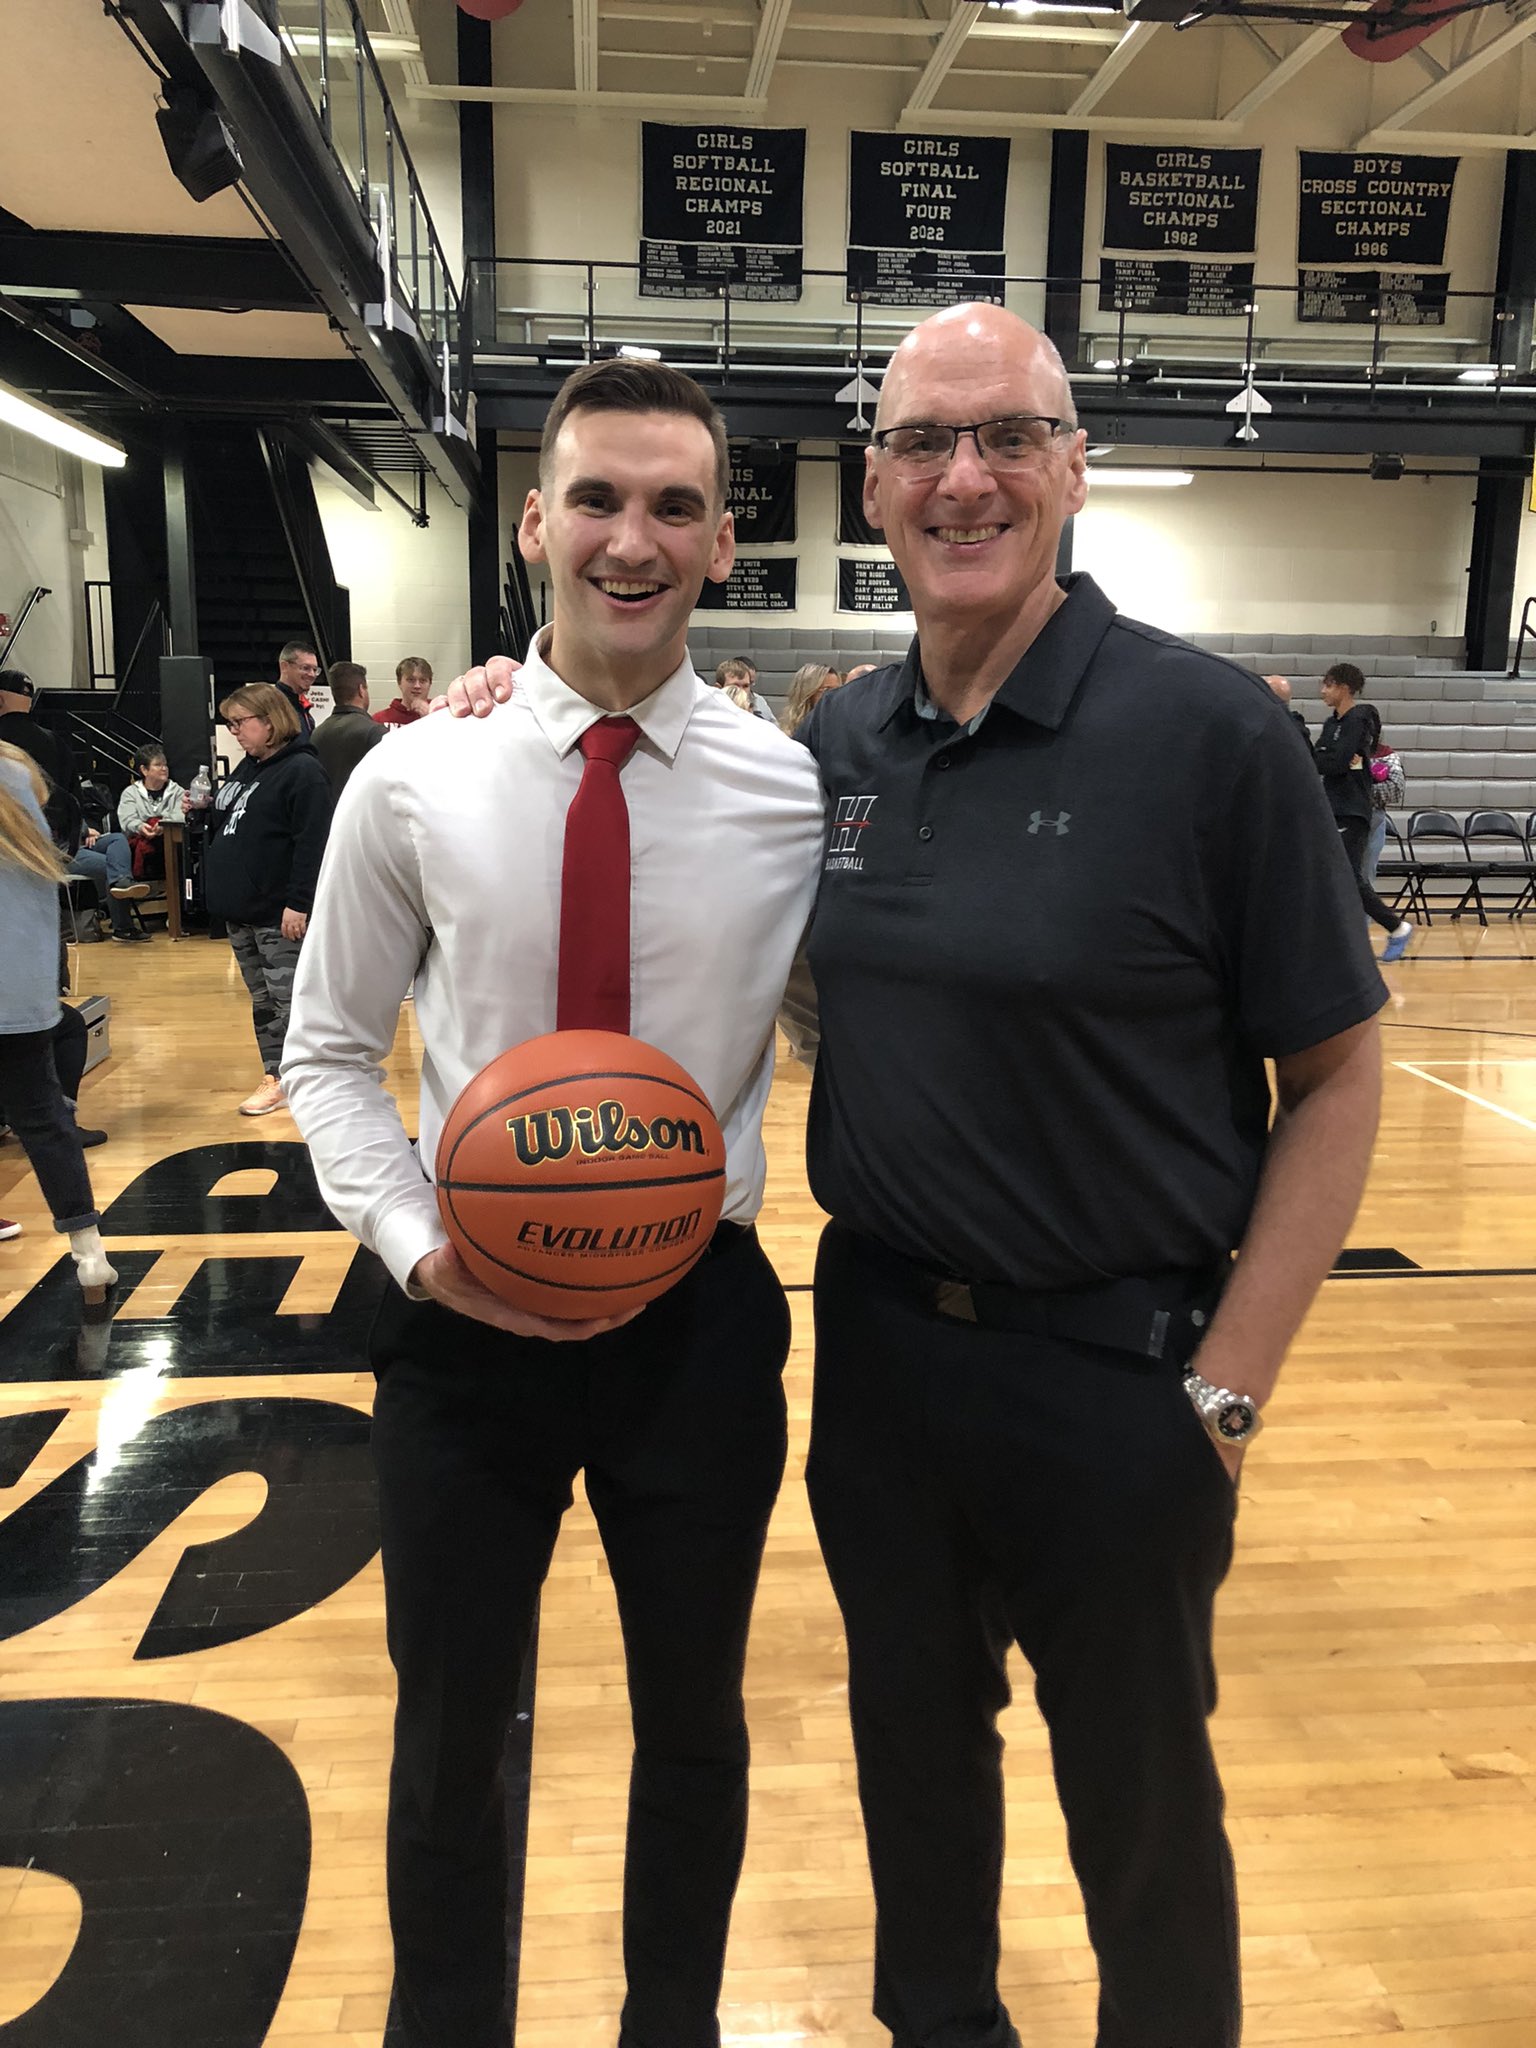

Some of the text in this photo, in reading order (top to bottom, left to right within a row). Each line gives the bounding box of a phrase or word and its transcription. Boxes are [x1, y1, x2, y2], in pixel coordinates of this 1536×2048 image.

[697, 133, 753, 150] GIRLS
[904, 139, 959, 156] GIRLS
[672, 155, 775, 173] SOFTBALL
[1156, 153, 1211, 168] GIRLS
[1354, 159, 1402, 174] BOYS
[880, 162, 979, 179] SOFTBALL
[676, 176, 773, 194] REGIONAL
[1120, 172, 1245, 189] BASKETBALL
[1302, 179, 1451, 197] CROSS COUNTRY
[901, 183, 957, 199] FINAL
[685, 198, 763, 215] CHAMPS
[1129, 192, 1235, 209] SECTIONAL
[1321, 200, 1427, 217] SECTIONAL
[905, 204, 951, 220] FOUR
[1143, 212, 1219, 228] CHAMPS
[706, 219, 741, 235] 2021
[910, 225, 945, 241] 2022
[1335, 221, 1411, 236] CHAMPS
[1163, 231, 1198, 246] 1982
[825, 856, 864, 871] BASKETBALL
[506, 1099, 707, 1167] Wilson
[576, 1157, 616, 1166] INDOOR
[517, 1207, 703, 1251] EVOLUTION
